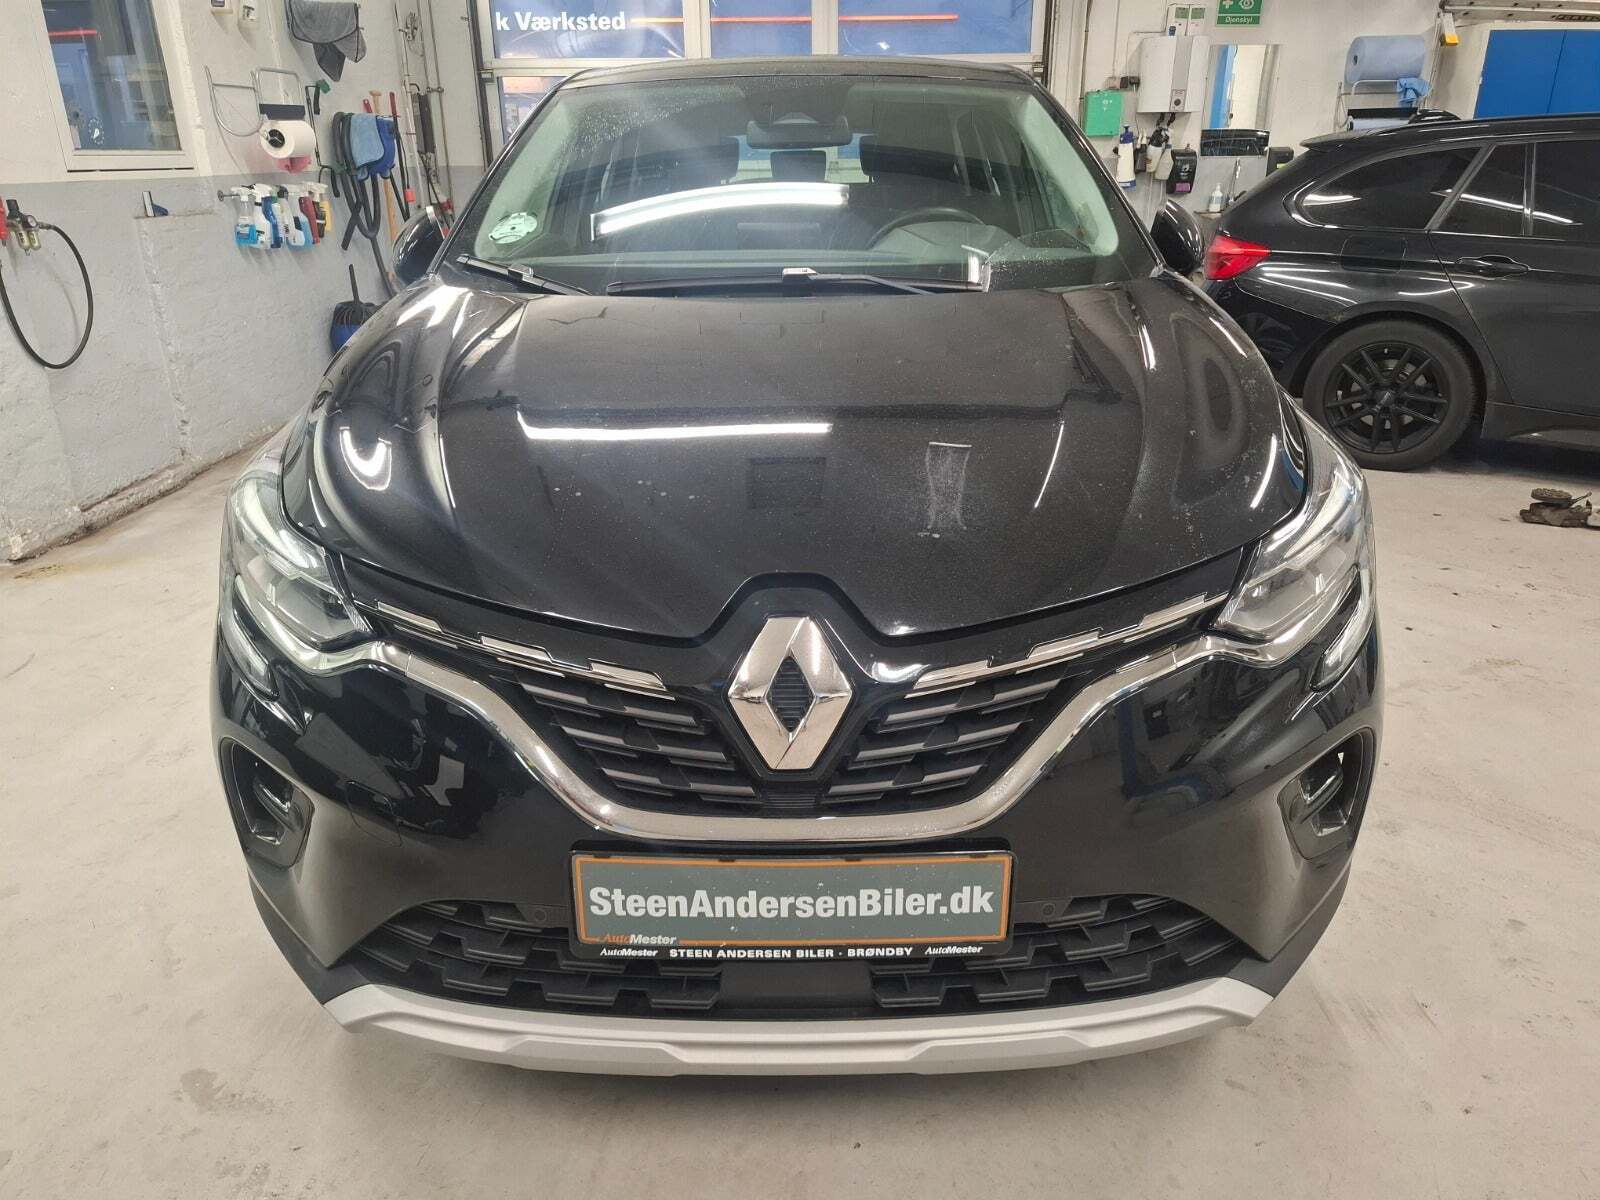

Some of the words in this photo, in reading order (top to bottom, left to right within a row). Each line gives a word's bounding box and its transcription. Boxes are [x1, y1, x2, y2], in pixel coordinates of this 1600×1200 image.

[495, 11, 511, 31] k
[514, 11, 626, 31] Værksted
[589, 885, 994, 918] SteenAndersenBiler.dk
[603, 933, 677, 945] AutoMester
[600, 948, 658, 957] AutoMester
[669, 949, 712, 958] STEEN
[716, 949, 792, 959] ANDERSEN
[796, 948, 834, 958] BILER
[847, 947, 914, 958] BRØNDBY
[924, 945, 983, 955] AutoMester
